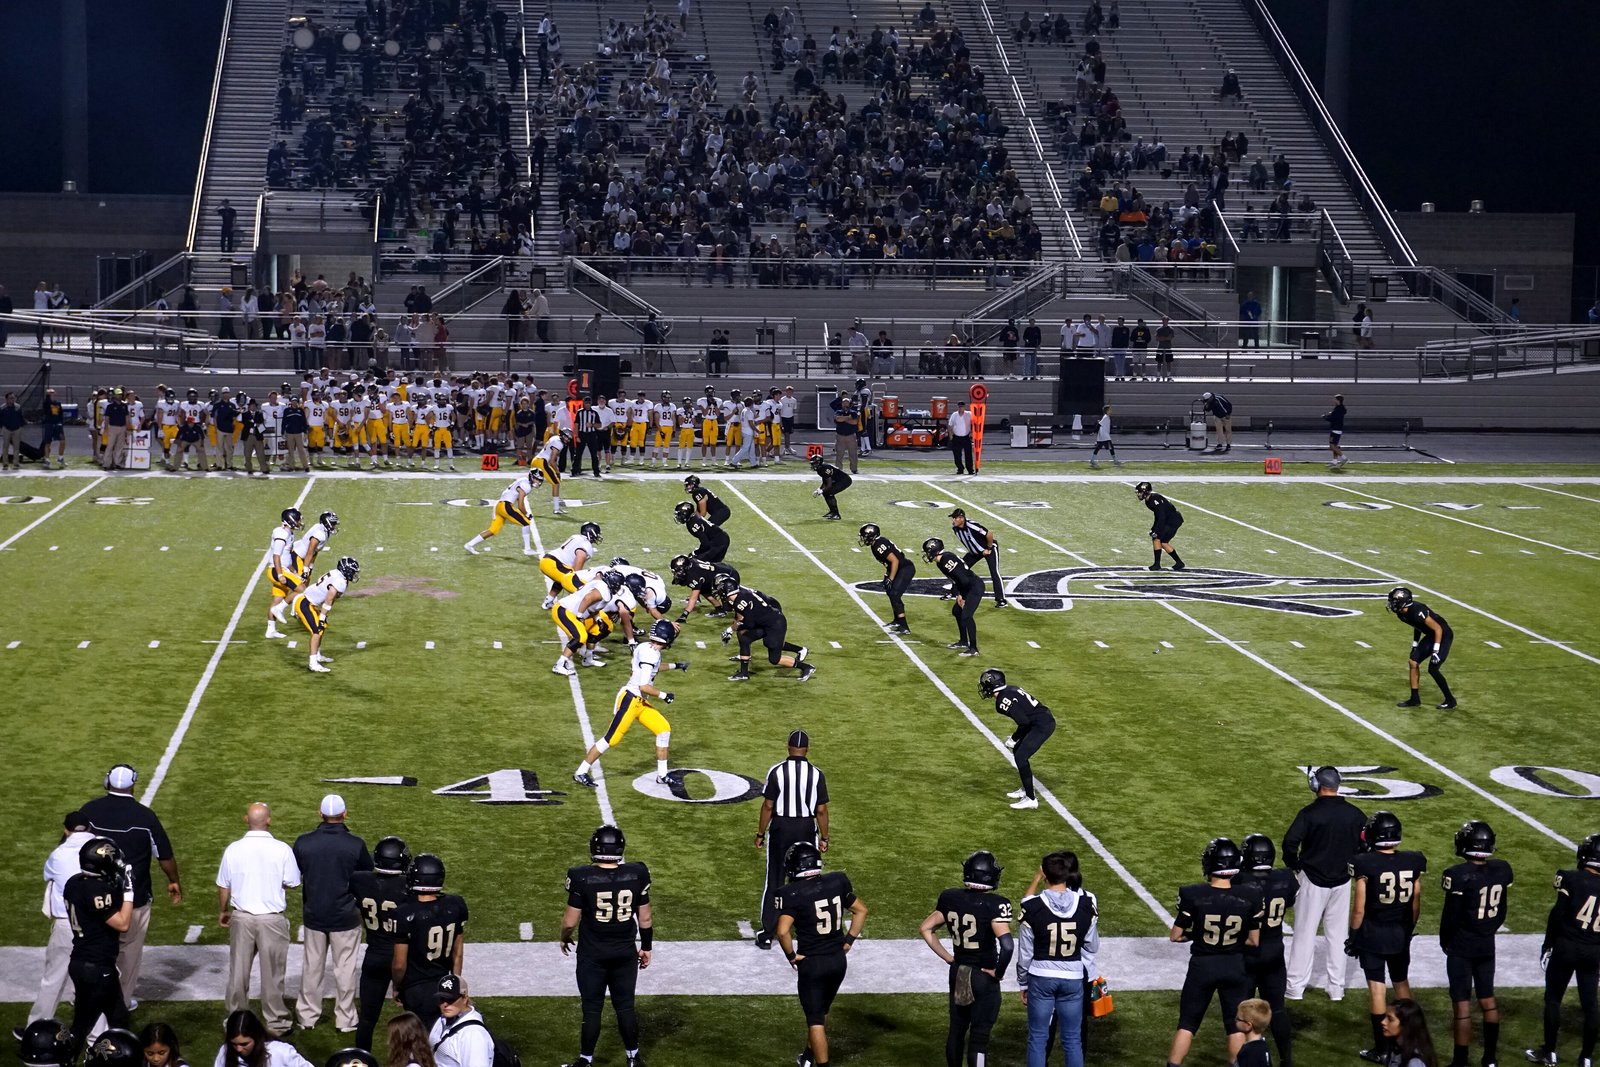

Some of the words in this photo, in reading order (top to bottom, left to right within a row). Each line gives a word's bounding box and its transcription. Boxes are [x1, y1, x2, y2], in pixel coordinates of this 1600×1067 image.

[313, 408, 323, 417] 63
[339, 408, 349, 417] 58
[395, 410, 405, 419] 62
[439, 413, 448, 421] 16
[615, 408, 625, 416] 65
[808, 446, 822, 456] 50
[483, 456, 496, 467] 40
[1267, 459, 1280, 471] 40
[691, 523, 701, 533] 42
[944, 559, 956, 571] 50
[737, 600, 748, 611] 90
[1418, 611, 1426, 619] 7
[999, 697, 1012, 711] 29
[1379, 870, 1414, 904] 35
[94, 893, 112, 910] 64
[595, 889, 633, 922] 58
[774, 897, 783, 909] 51
[1477, 884, 1503, 920] 19
[815, 895, 843, 935] 51
[998, 903, 1013, 917] 32
[947, 911, 979, 949] 32
[1203, 914, 1243, 946] 52
[426, 922, 456, 962] 91
[1047, 922, 1077, 957] 15
